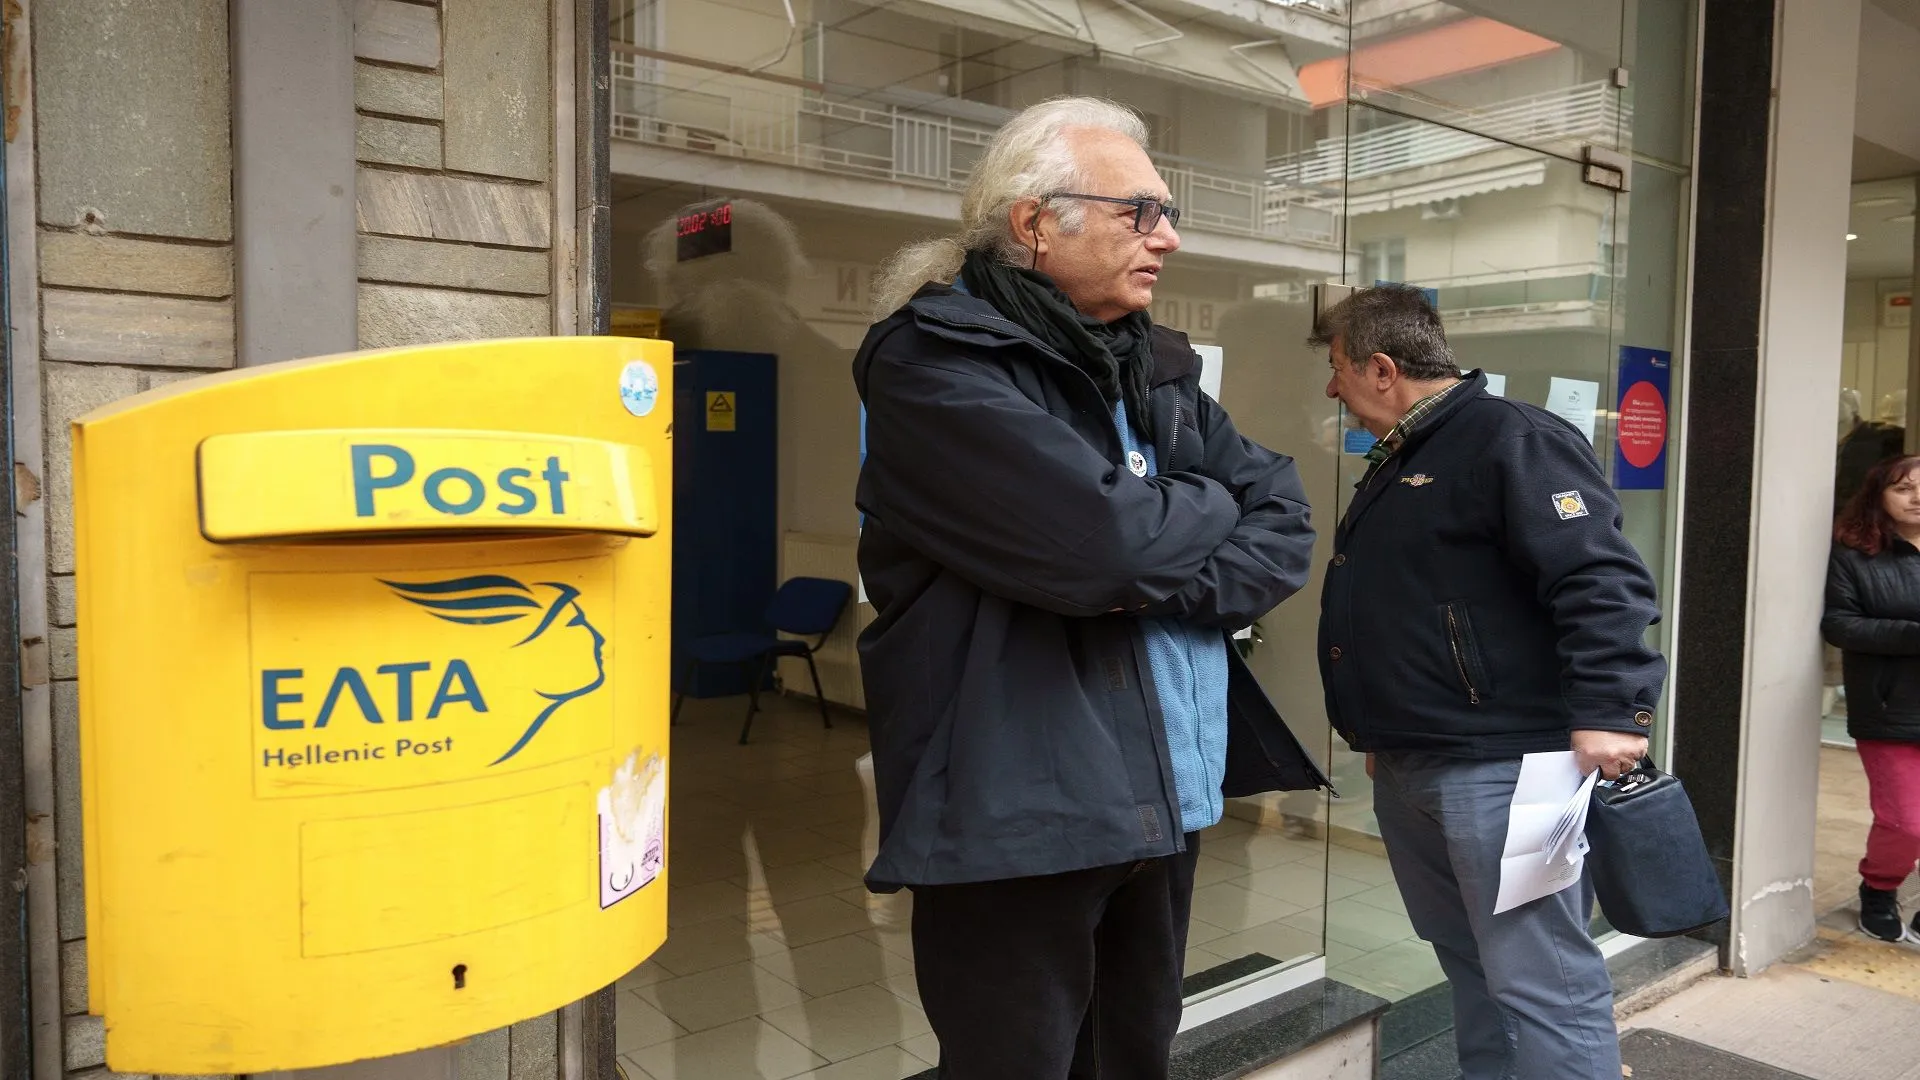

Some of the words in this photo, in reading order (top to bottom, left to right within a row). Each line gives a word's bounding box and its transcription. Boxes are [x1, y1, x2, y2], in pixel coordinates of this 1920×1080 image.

[351, 444, 570, 517] Post
[262, 659, 489, 730] ΕΛΤΑ
[263, 743, 385, 768] Hellenic
[396, 736, 453, 757] Post
